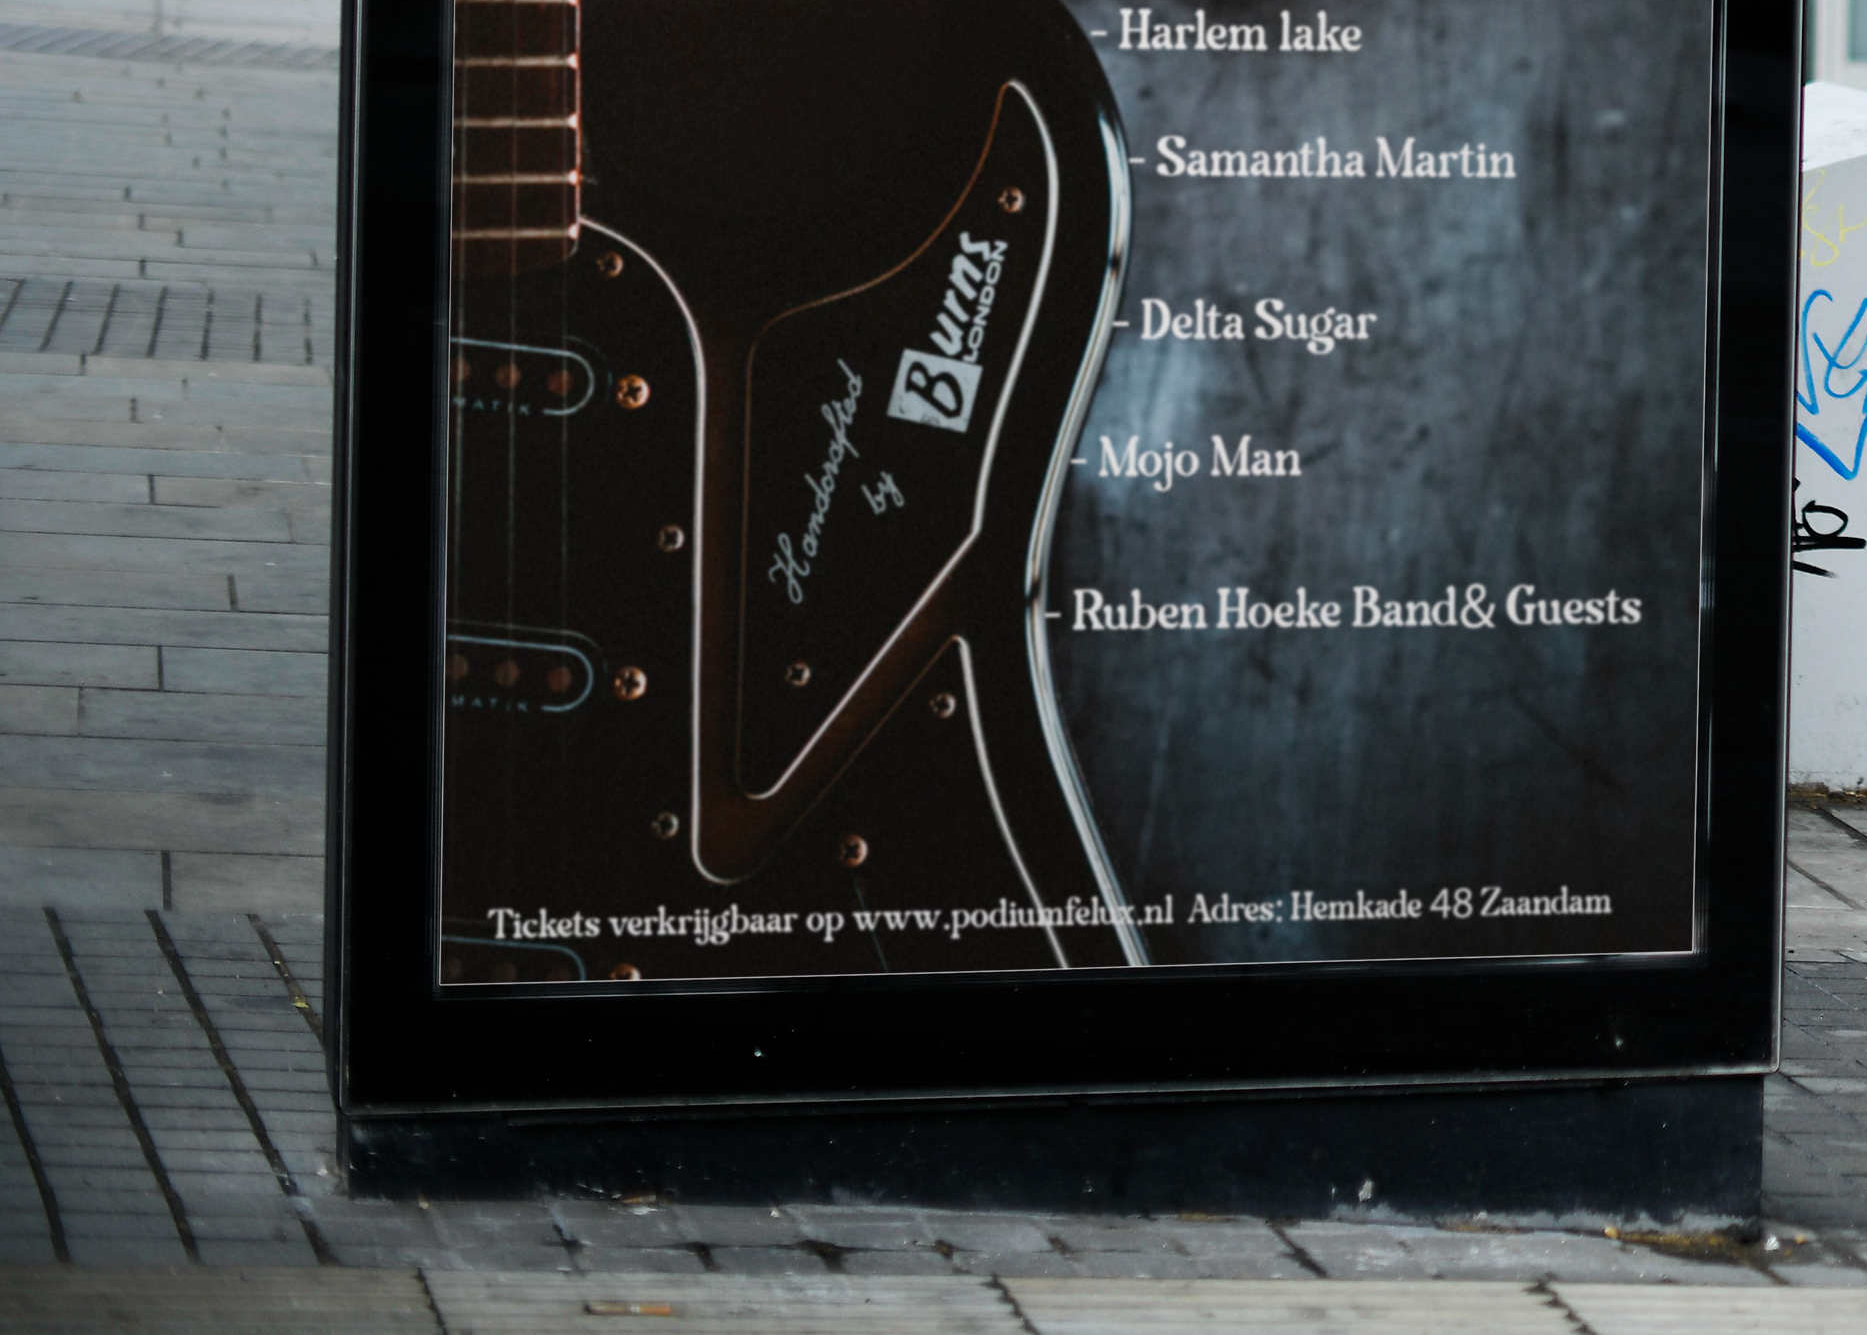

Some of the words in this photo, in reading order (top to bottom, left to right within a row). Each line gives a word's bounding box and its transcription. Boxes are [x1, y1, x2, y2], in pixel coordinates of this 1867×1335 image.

[1118, 8, 1267, 51] Harlem
[1279, 10, 1362, 52] lake
[1156, 135, 1366, 178] Samantha
[1375, 135, 1517, 179] Martin
[962, 239, 1008, 364] LONDON
[1140, 298, 1244, 341] Delta
[1255, 298, 1377, 355] Sugar
[887, 231, 992, 433] Burns
[1098, 435, 1200, 492] Mojo
[1211, 435, 1302, 476] Man
[861, 471, 905, 515] by
[1073, 588, 1207, 630] Ruben
[1216, 587, 1341, 629] Hoeke
[1506, 585, 1641, 625] Guests
[487, 907, 601, 940] Tickets
[608, 903, 799, 945] verkrijgbaar
[806, 912, 845, 943] op
[1188, 893, 1284, 923] Adres:
[1290, 889, 1422, 922] Hemkade
[1430, 887, 1473, 918] 48
[1480, 885, 1612, 916] Zaandam
